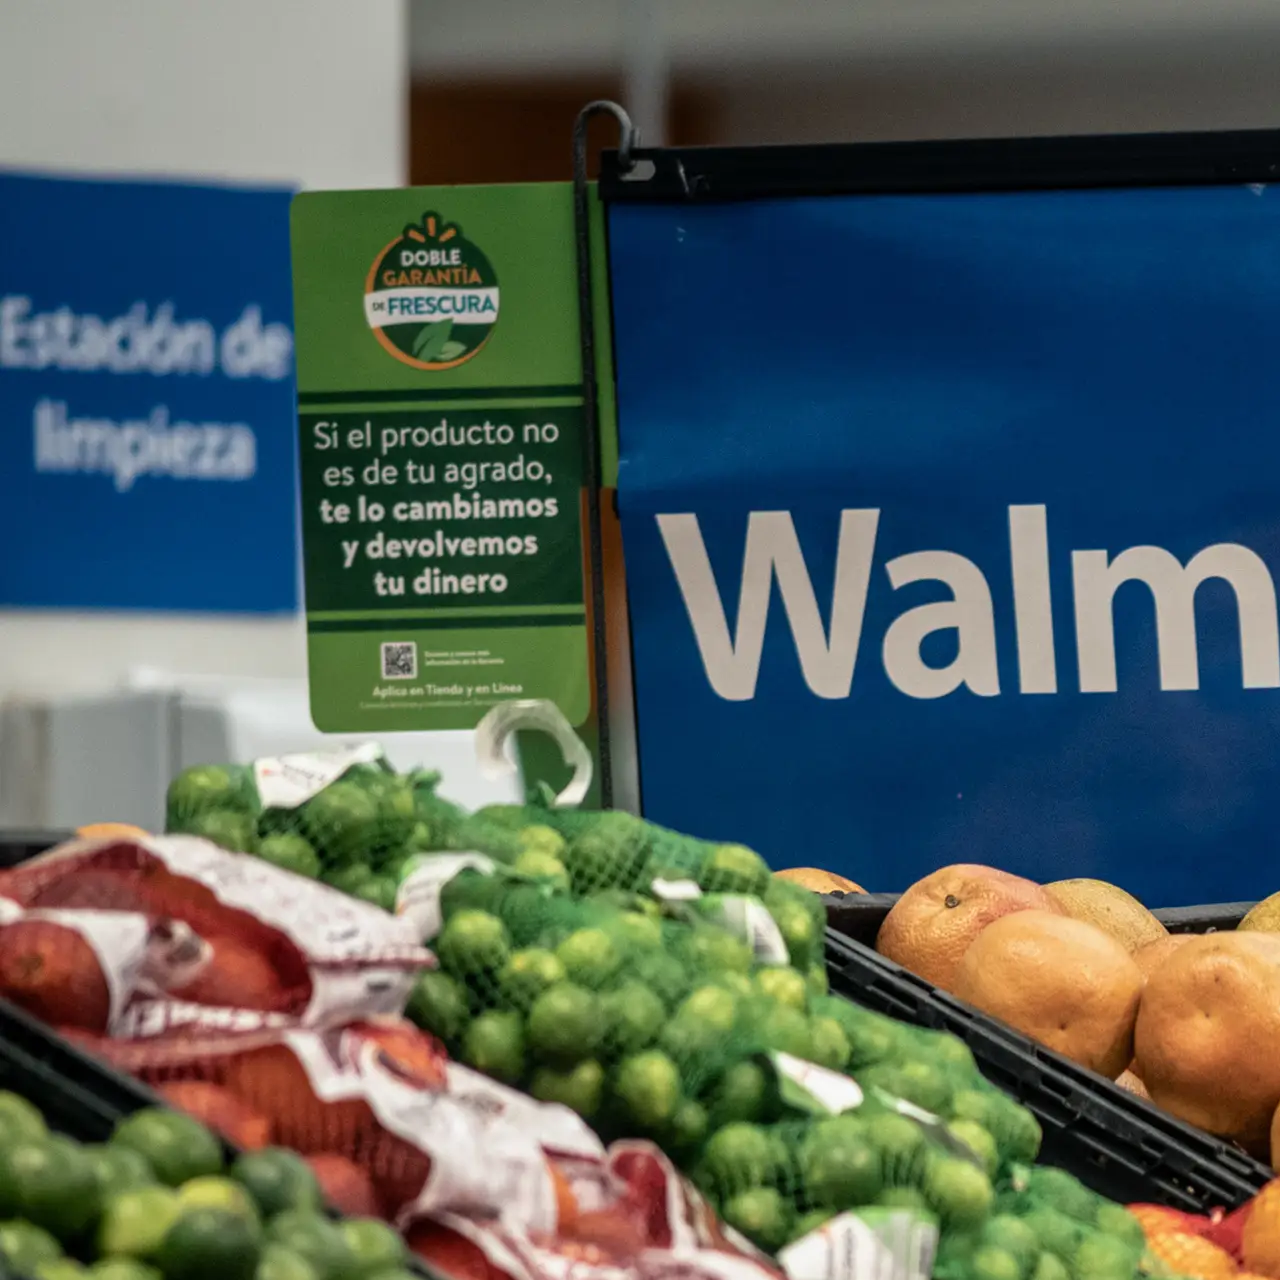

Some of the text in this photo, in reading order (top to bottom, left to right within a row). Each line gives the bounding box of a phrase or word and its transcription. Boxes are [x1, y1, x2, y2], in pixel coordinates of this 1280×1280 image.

[400, 248, 462, 267] DOBLE
[382, 264, 483, 287] GARANTÍA
[372, 294, 496, 316] DE FRESCURA
[221, 303, 293, 379] de
[34, 399, 256, 492] limpieza
[313, 418, 559, 456] Si el producto no
[323, 453, 553, 490] es de tu agrado,
[319, 491, 559, 524] te lo cambiamos
[341, 530, 538, 569] y devolvemos
[373, 567, 508, 596] tu dinero
[372, 685, 408, 699] Aplica
[410, 686, 425, 696] en
[425, 683, 464, 696] Tienda
[466, 686, 474, 698] y
[475, 684, 490, 694] en
